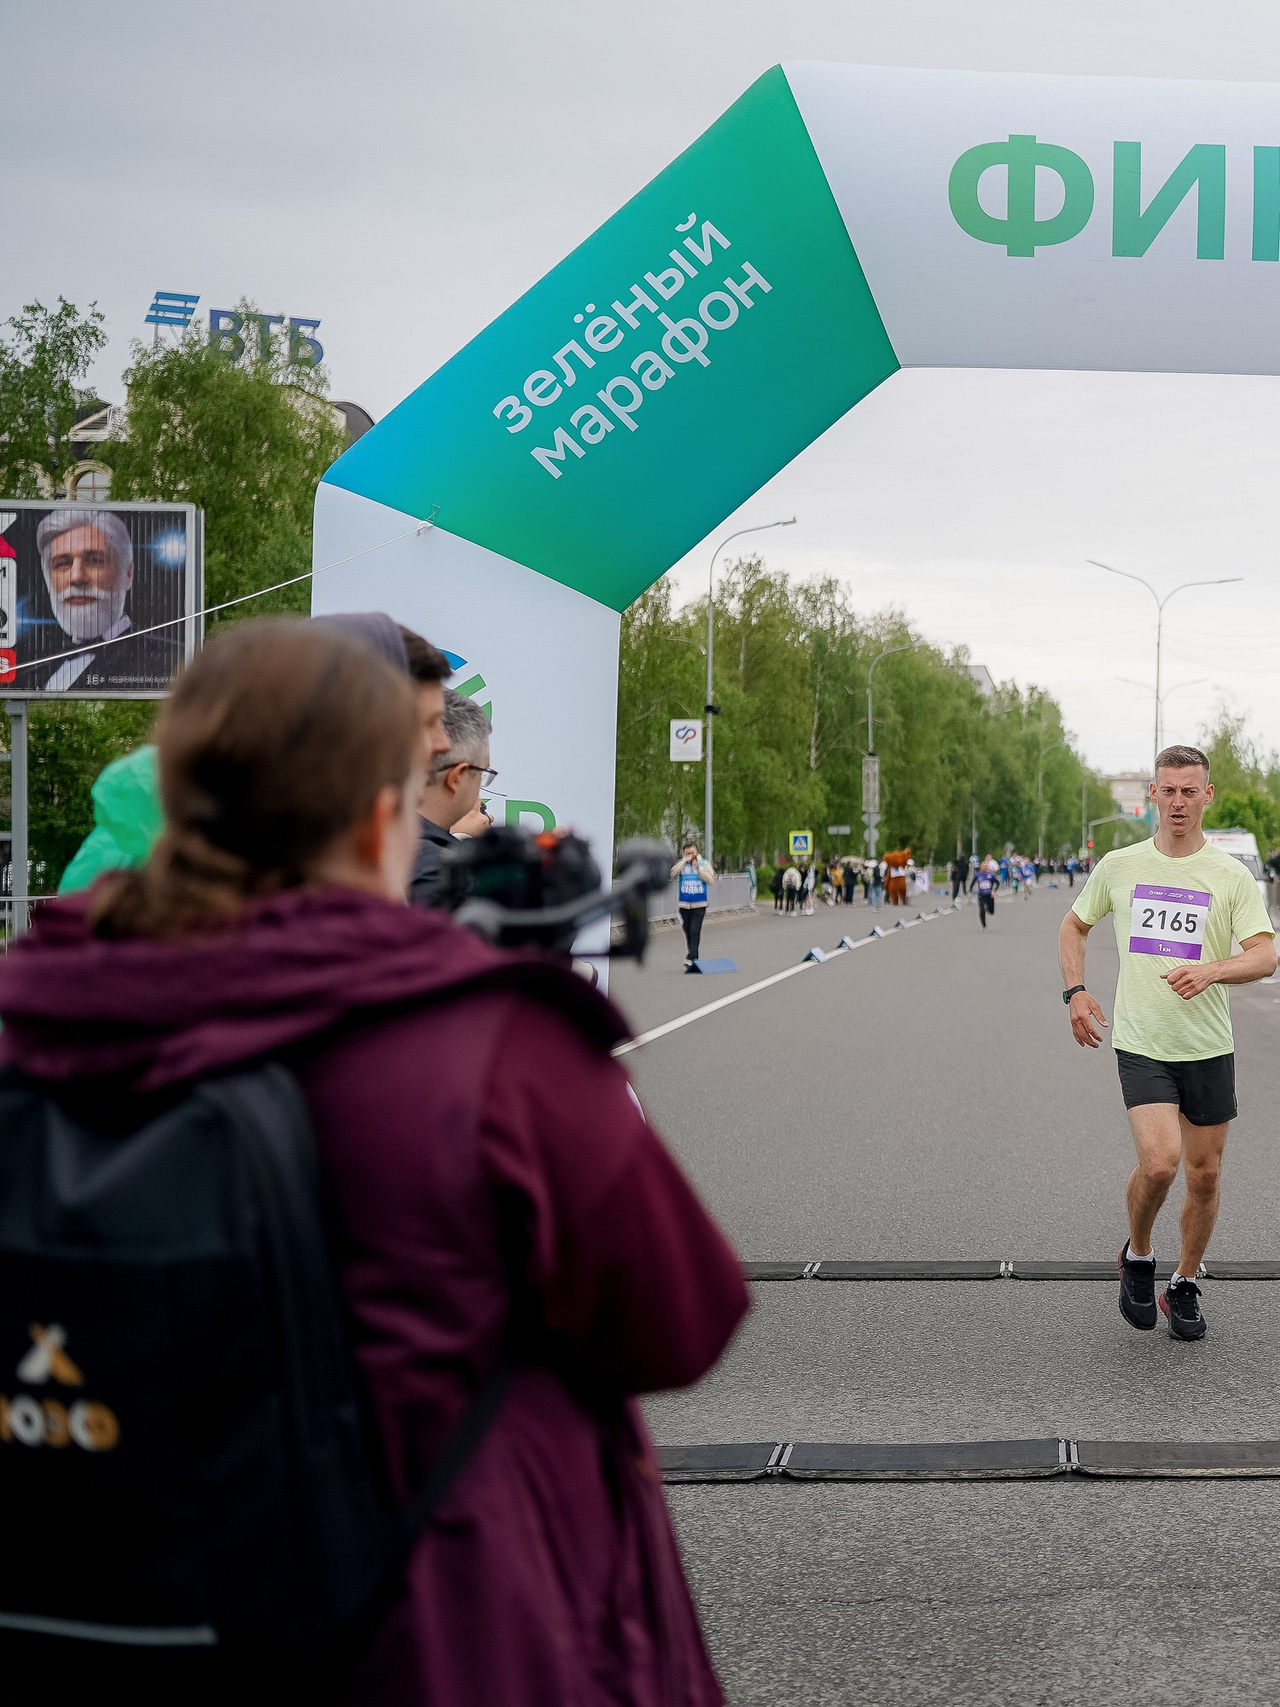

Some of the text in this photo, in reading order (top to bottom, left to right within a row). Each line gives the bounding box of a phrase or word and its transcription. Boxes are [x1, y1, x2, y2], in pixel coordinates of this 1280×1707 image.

[209, 309, 324, 369] ВТБ
[492, 211, 732, 434] зелёный
[529, 260, 773, 479] марафон
[1142, 907, 1198, 934] 2165
